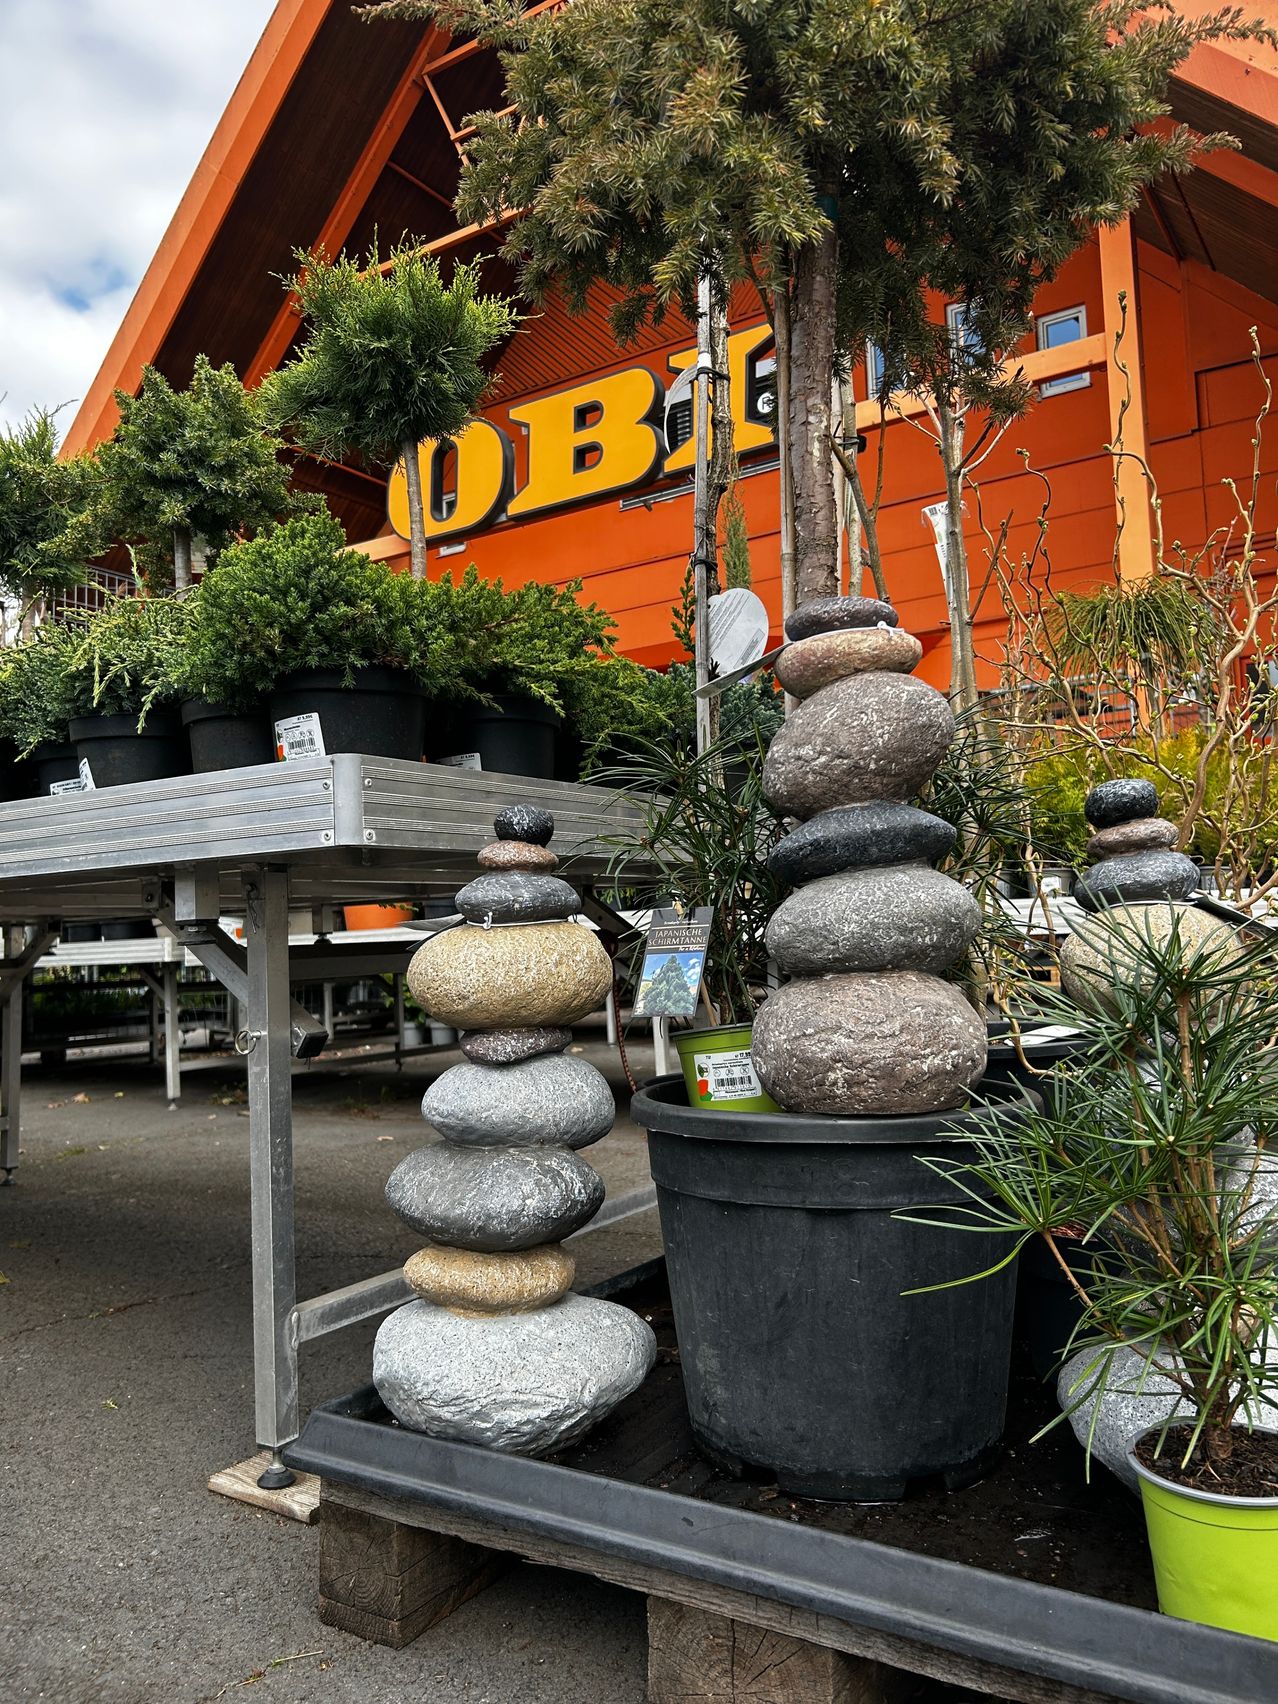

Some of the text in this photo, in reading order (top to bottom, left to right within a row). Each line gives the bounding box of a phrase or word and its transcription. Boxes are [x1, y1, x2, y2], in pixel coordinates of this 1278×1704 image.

[386, 323, 776, 541] OBI
[655, 928, 703, 938] JAPANISCHE
[648, 936, 707, 946] SCHIRMTANNE
